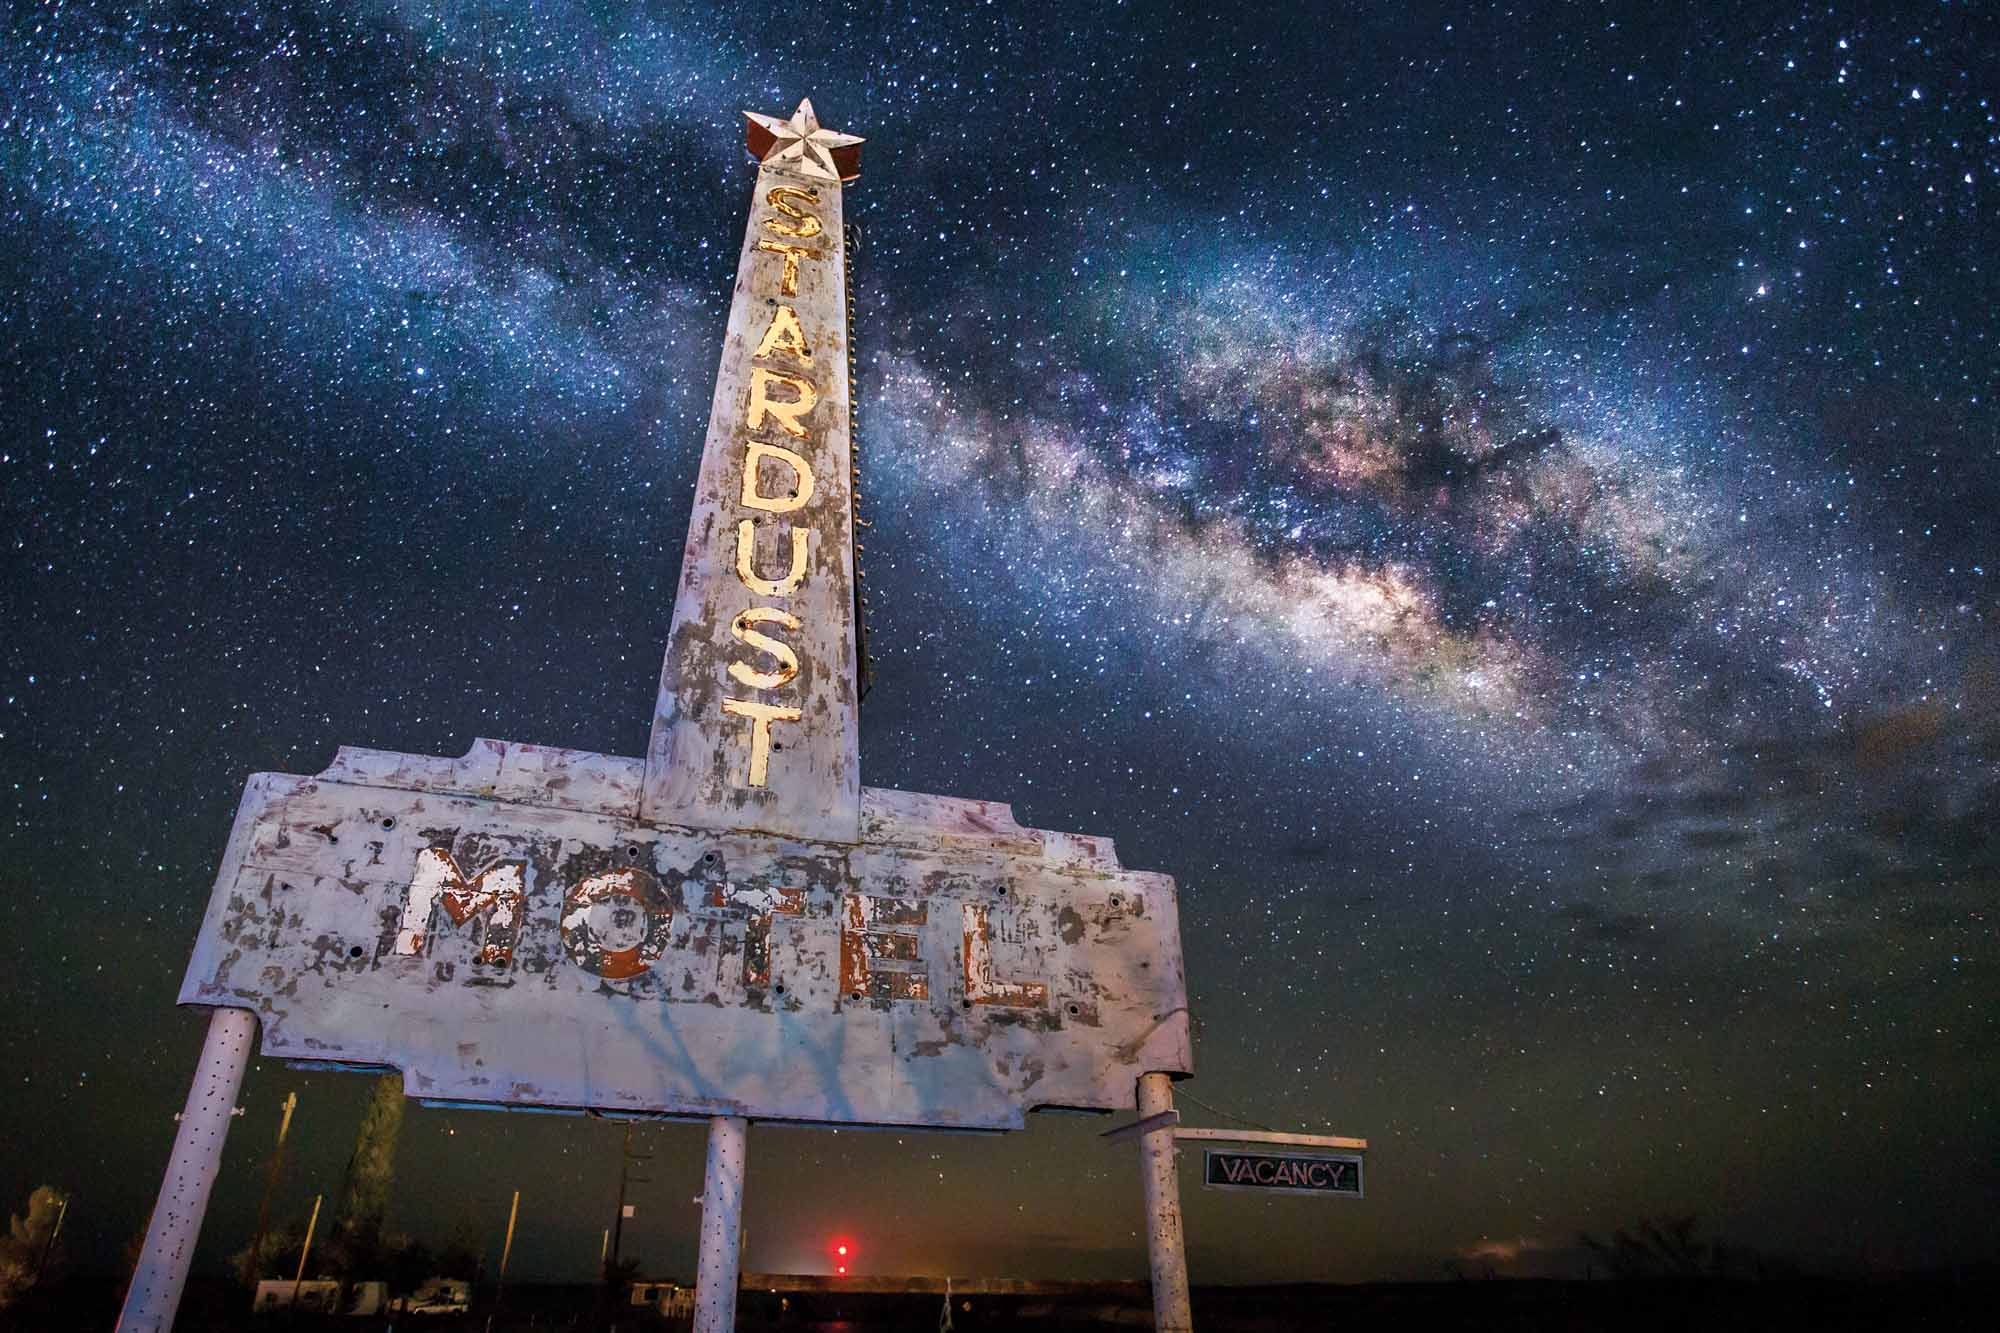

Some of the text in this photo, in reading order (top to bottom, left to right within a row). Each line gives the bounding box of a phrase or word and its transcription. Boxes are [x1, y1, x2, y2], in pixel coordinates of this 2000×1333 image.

[721, 186, 823, 787] STARDUST
[396, 848, 1048, 1007] MOTEL
[1220, 1157, 1344, 1188] VACANCY
